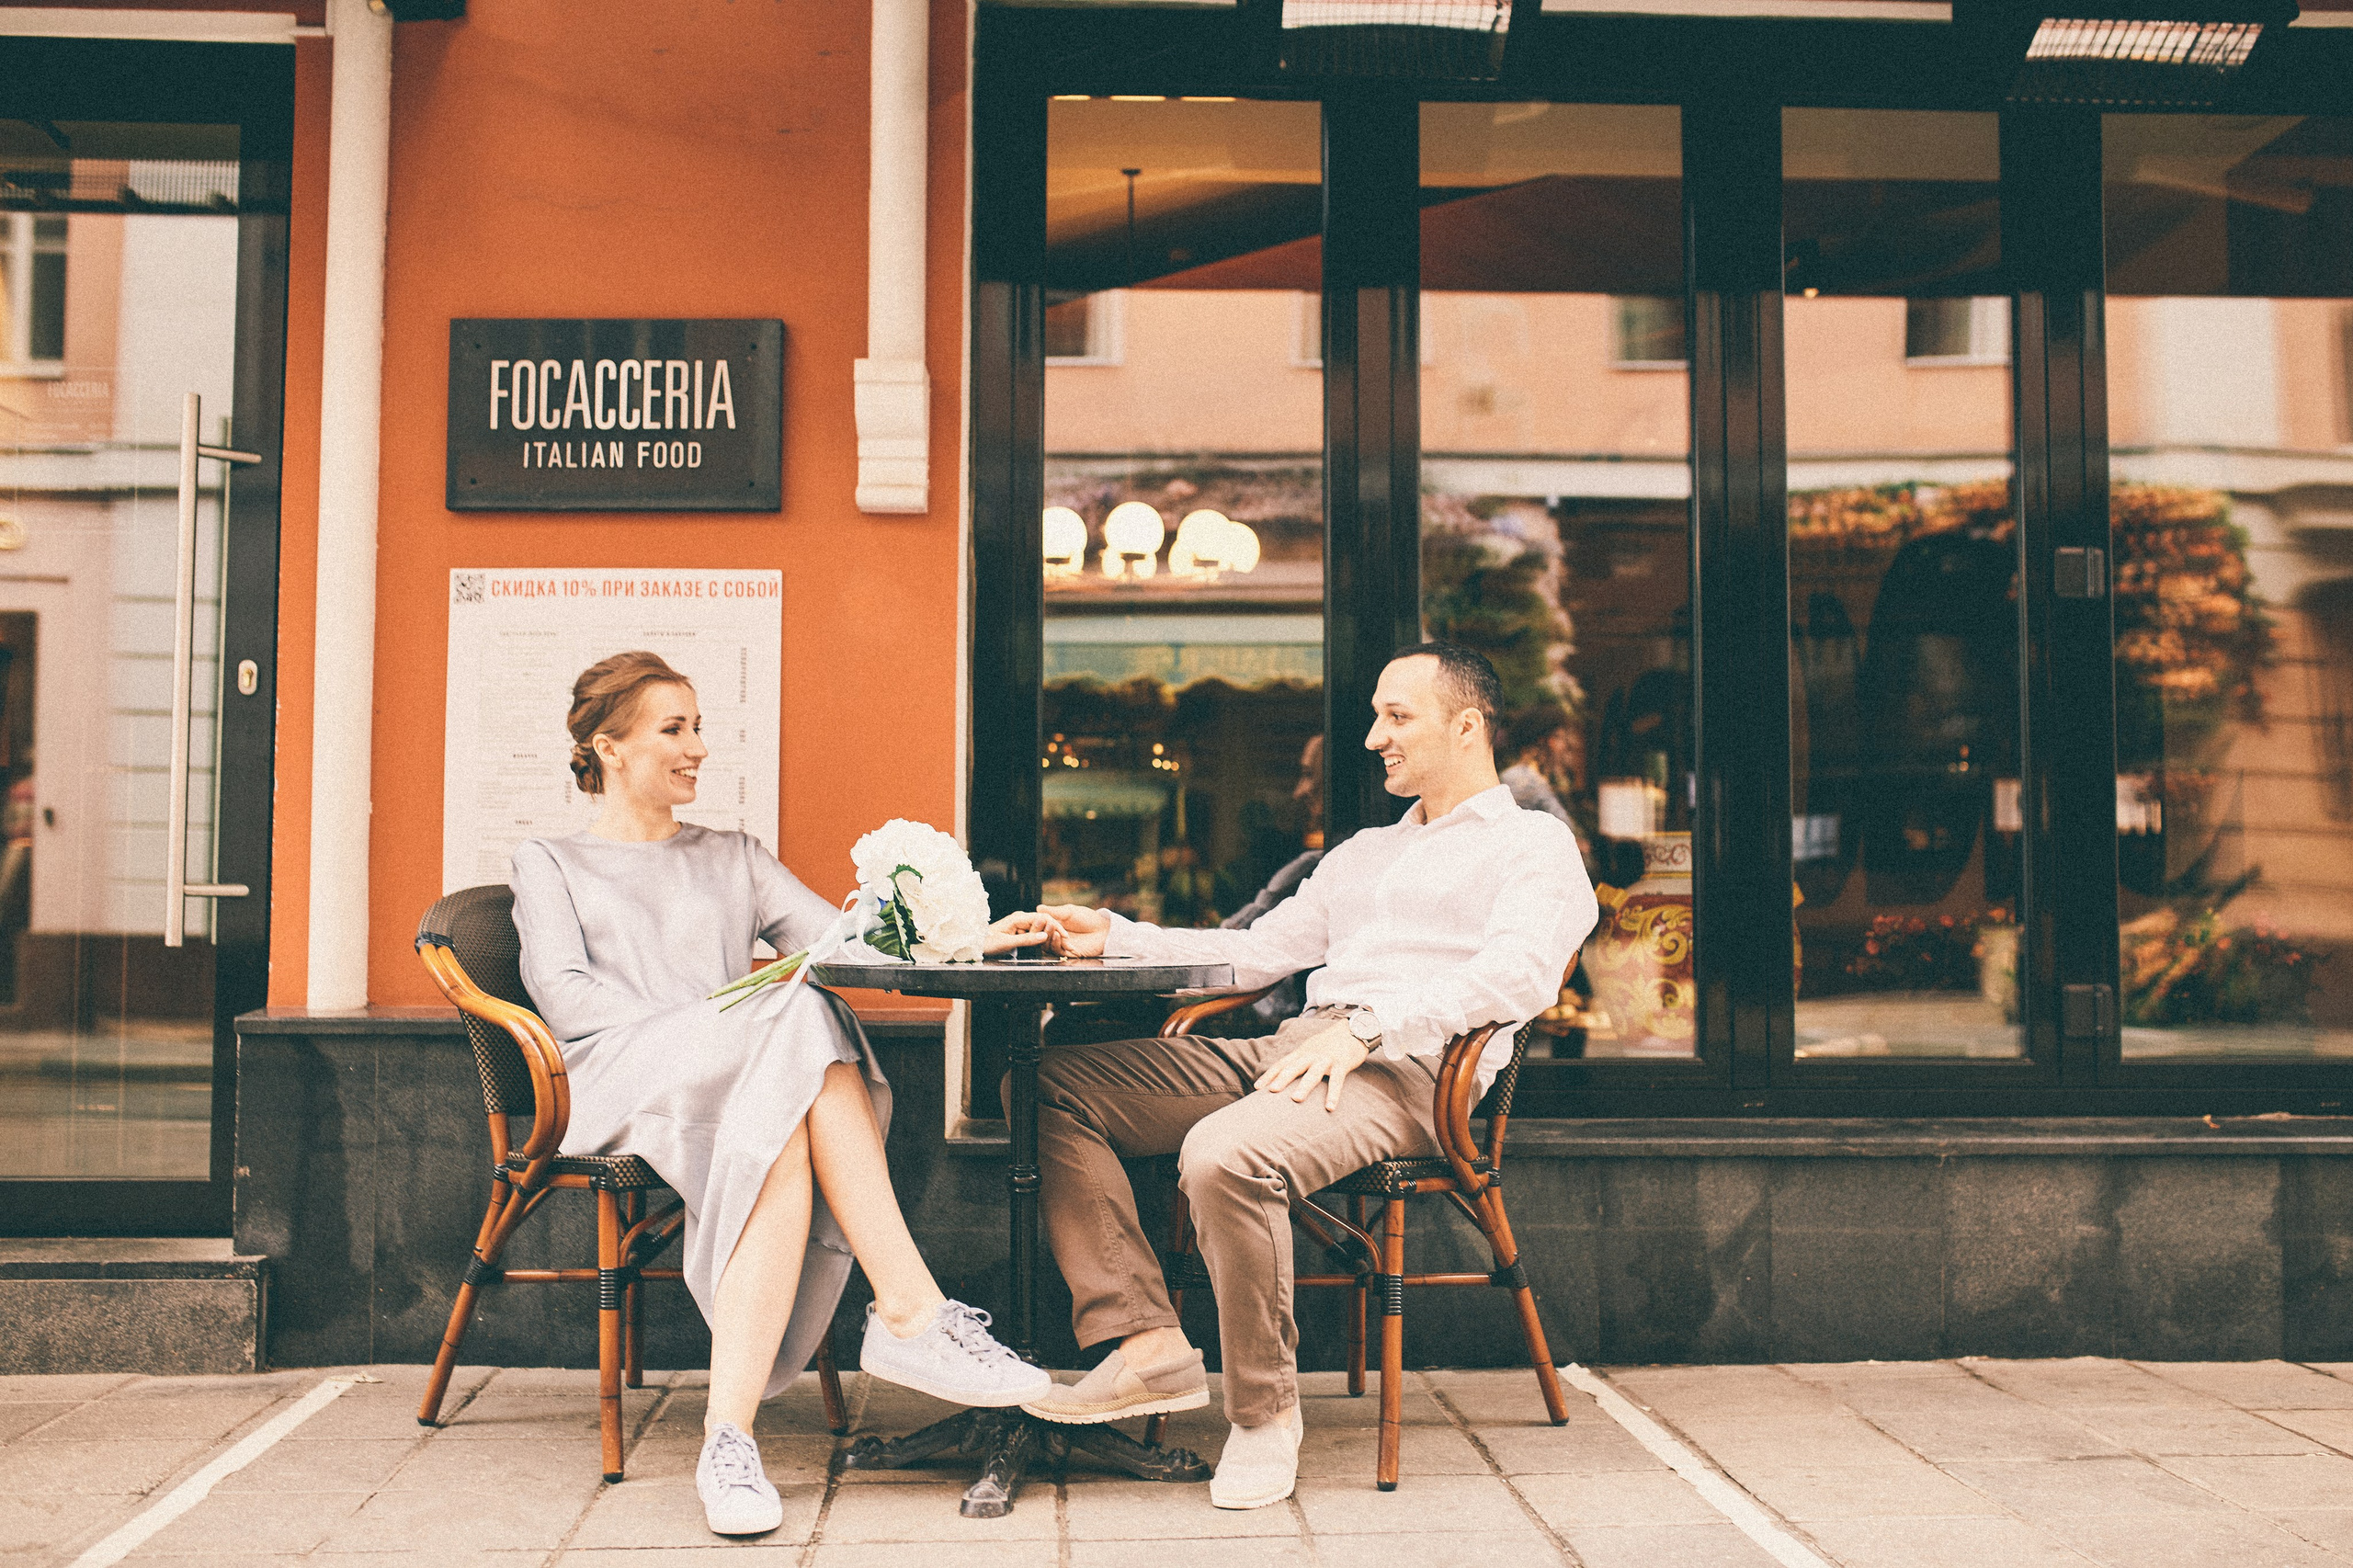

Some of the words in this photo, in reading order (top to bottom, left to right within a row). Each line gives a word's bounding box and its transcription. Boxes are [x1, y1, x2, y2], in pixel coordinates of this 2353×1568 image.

[489, 359, 735, 430] FOCACCERIA
[523, 441, 624, 469] ITALIAN
[637, 441, 702, 469] FOOD
[491, 580, 556, 597] СКИДКА
[563, 580, 597, 597] 10%
[602, 580, 635, 597] ПРИ
[641, 581, 703, 597] ЗАКАЗЕ
[709, 581, 719, 597] С
[723, 577, 779, 597] СОБОЙ
